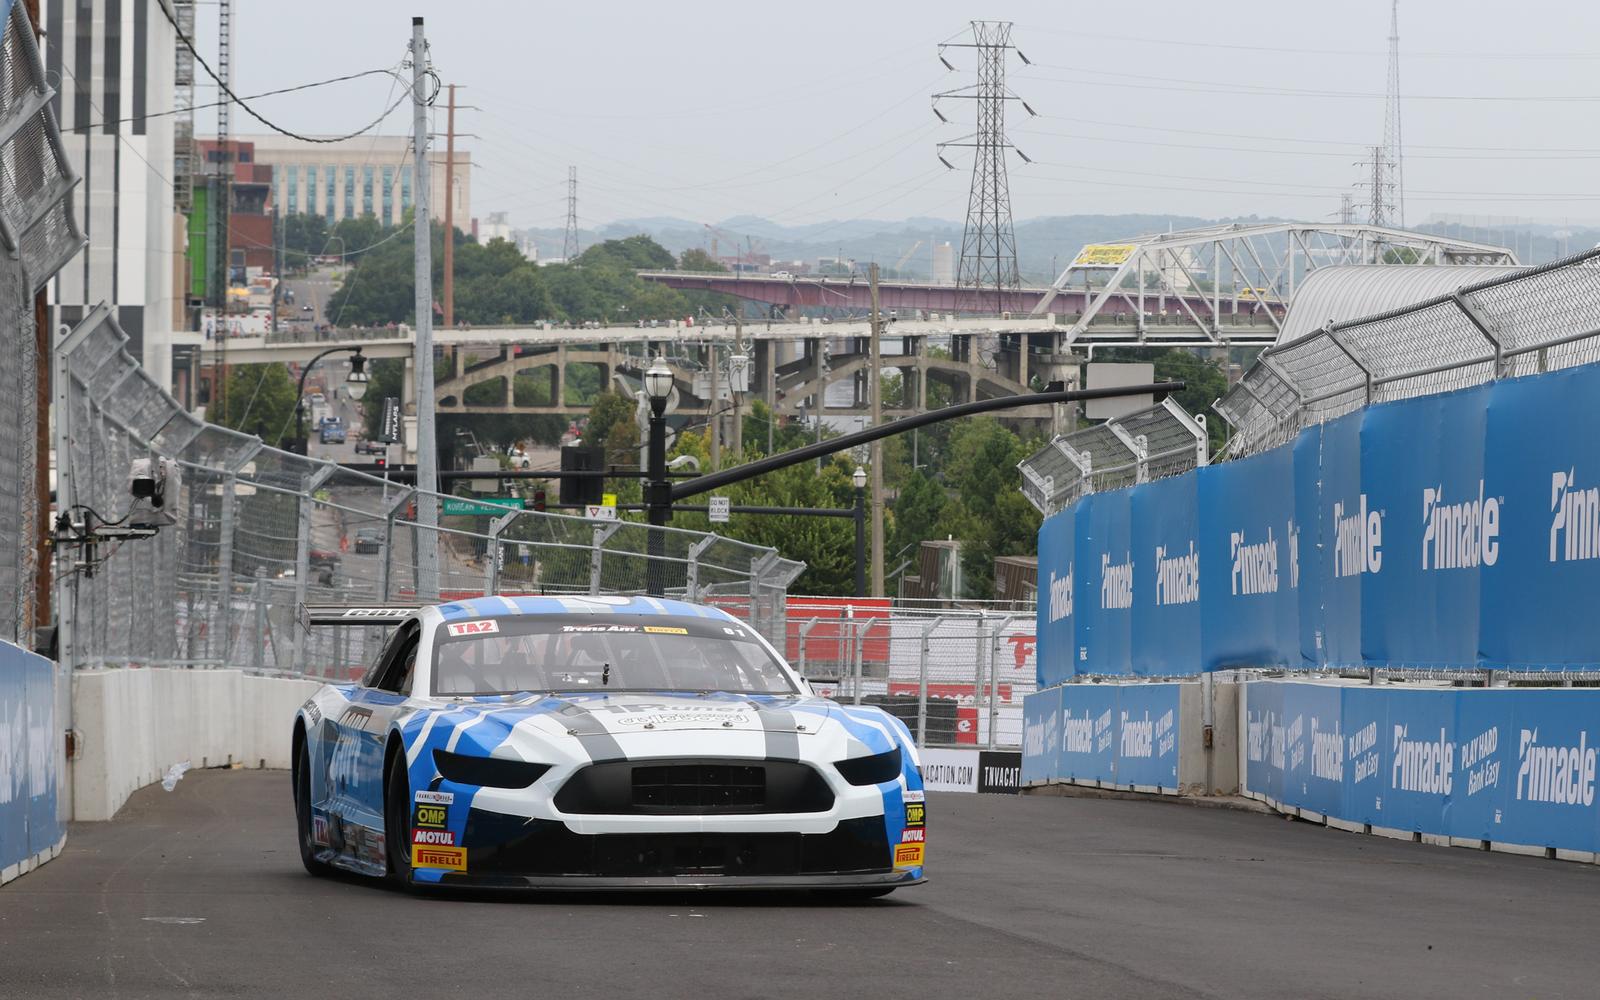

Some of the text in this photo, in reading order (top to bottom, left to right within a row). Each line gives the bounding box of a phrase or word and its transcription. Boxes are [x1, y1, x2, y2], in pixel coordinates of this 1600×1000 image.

[446, 502, 475, 512] KOREAN
[1422, 479, 1500, 571] Pinnacle
[1549, 466, 1600, 563] Pinn
[1155, 540, 1200, 606] Pinnacle
[1230, 526, 1279, 596] Pinnacle
[453, 621, 494, 634] TA2
[1063, 707, 1093, 753] Pinnacle
[1120, 709, 1153, 758] Pinnacle
[1311, 717, 1345, 783] Pinnacle
[1461, 726, 1498, 771] PLAY HARD
[922, 764, 973, 786] ACATION.COM
[1392, 723, 1453, 795] Pinnacle
[1468, 760, 1500, 796] Bank Easy
[1516, 726, 1596, 807] Pinnacle
[414, 831, 453, 844] MOTUL
[418, 808, 446, 824] OMP
[901, 829, 924, 842] MOTUL
[906, 808, 924, 822] OMP
[417, 848, 463, 866] PIRELLI
